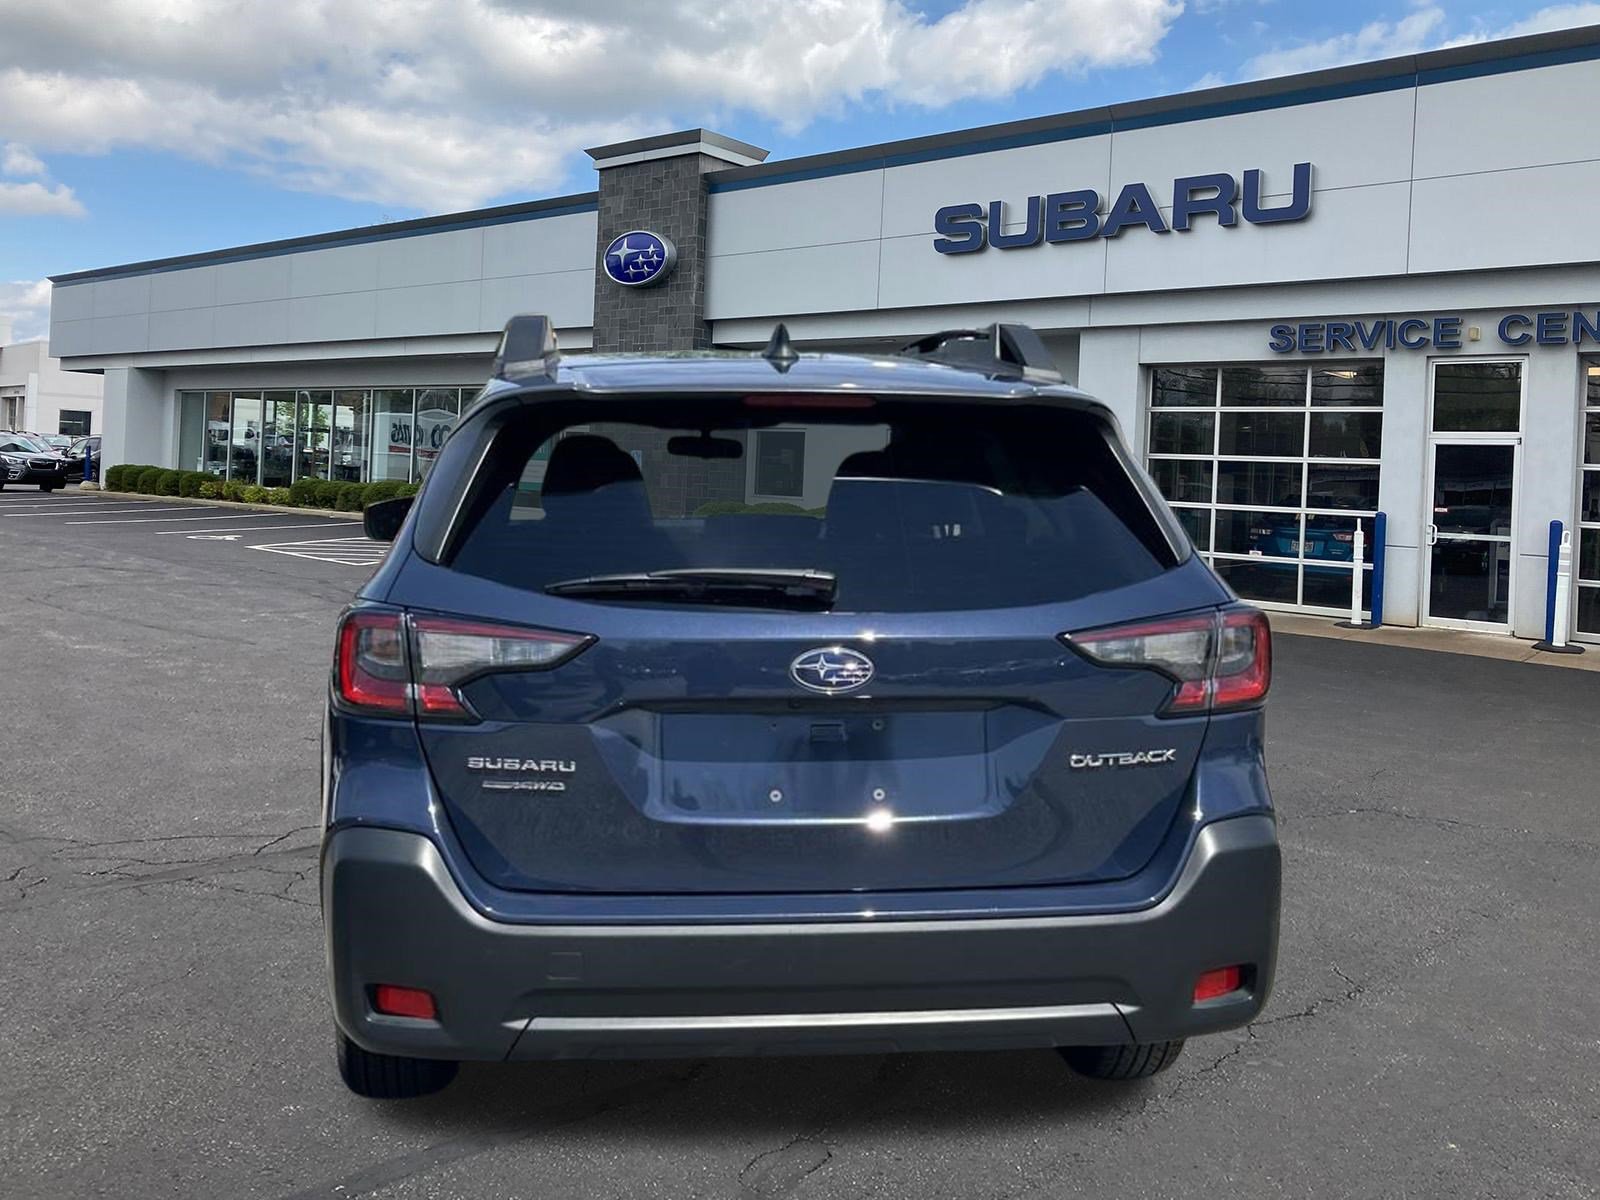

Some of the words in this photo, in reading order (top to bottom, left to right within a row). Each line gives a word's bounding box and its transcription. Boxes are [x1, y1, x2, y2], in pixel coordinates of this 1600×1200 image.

[933, 162, 1313, 255] SUBARU
[1269, 317, 1463, 353] SERVICE
[1497, 312, 1600, 346] CEN
[467, 757, 576, 772] SUBARU
[1070, 749, 1177, 767] OUTBACK
